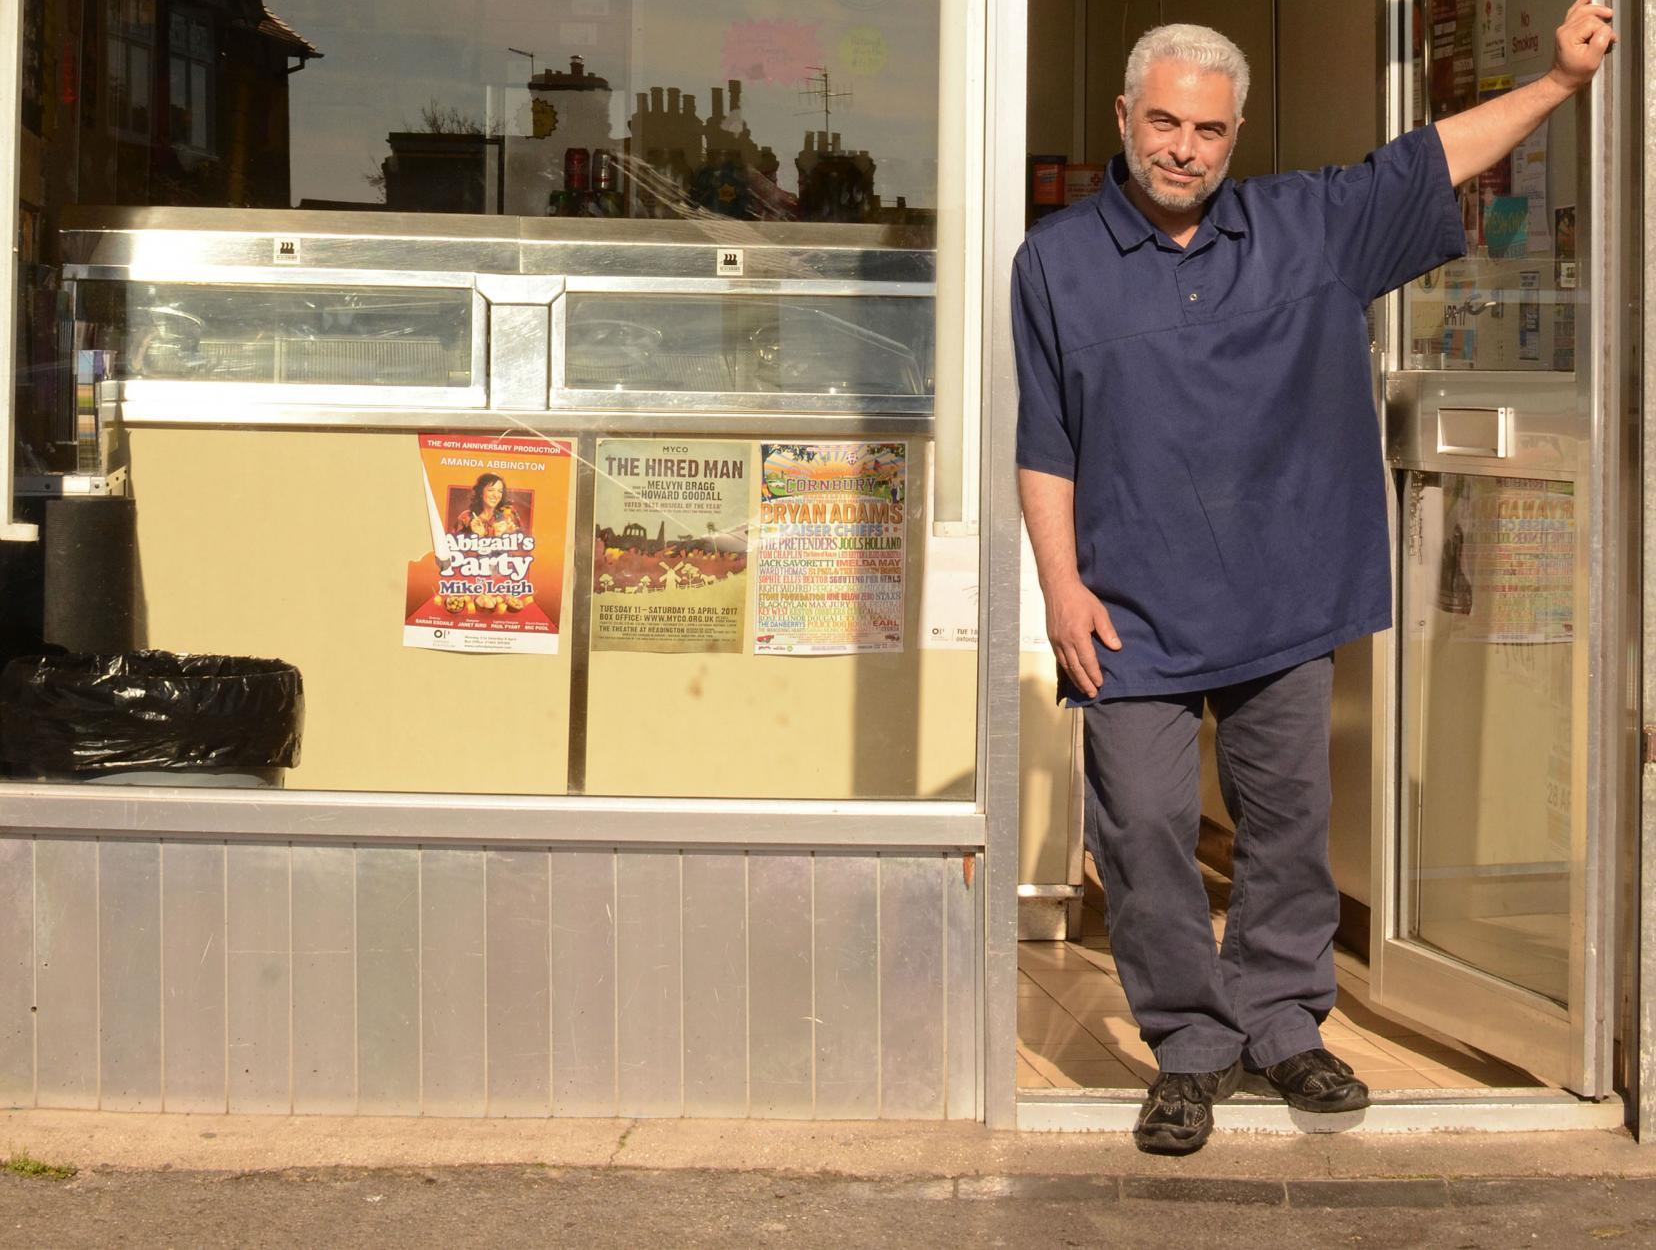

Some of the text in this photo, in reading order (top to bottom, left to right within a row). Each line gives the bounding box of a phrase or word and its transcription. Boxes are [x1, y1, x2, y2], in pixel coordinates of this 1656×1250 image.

[1520, 9, 1530, 28] No
[1512, 34, 1539, 54] Smoking
[427, 439, 561, 454] THE 40TH ANNIVERSARY PRODUCTION
[662, 445, 689, 454] MYCO
[440, 457, 546, 471] AMANDA ABBINGTON
[605, 456, 743, 479] THE HIRED MAN
[647, 480, 683, 490] MELVYN
[685, 481, 715, 491] BRAGG
[786, 477, 876, 495] CORNBURY
[641, 490, 679, 500] HOWARD
[682, 491, 722, 501] GOODALL
[761, 503, 903, 524] BRYAN ADAMS
[779, 524, 884, 537] KAISER CHIEFS
[445, 533, 534, 555] Abigail's
[778, 537, 837, 550] PRETENDERS
[839, 537, 865, 550] JOOLS
[865, 537, 902, 550] HOLLAND
[440, 551, 533, 581] Party
[759, 559, 901, 567] JACK SAVORETTI IMELDA MAY
[780, 567, 807, 575] THOMAS
[440, 581, 533, 596] Mike Leigh
[600, 605, 632, 613] TUESDAY
[648, 606, 685, 614] SATURDAY
[697, 607, 718, 615] APRIL
[721, 607, 738, 615] 2017
[615, 613, 642, 622] OFFICE:
[644, 614, 714, 623] WWW.MYCO.ORG.UK
[872, 619, 899, 627] EARL
